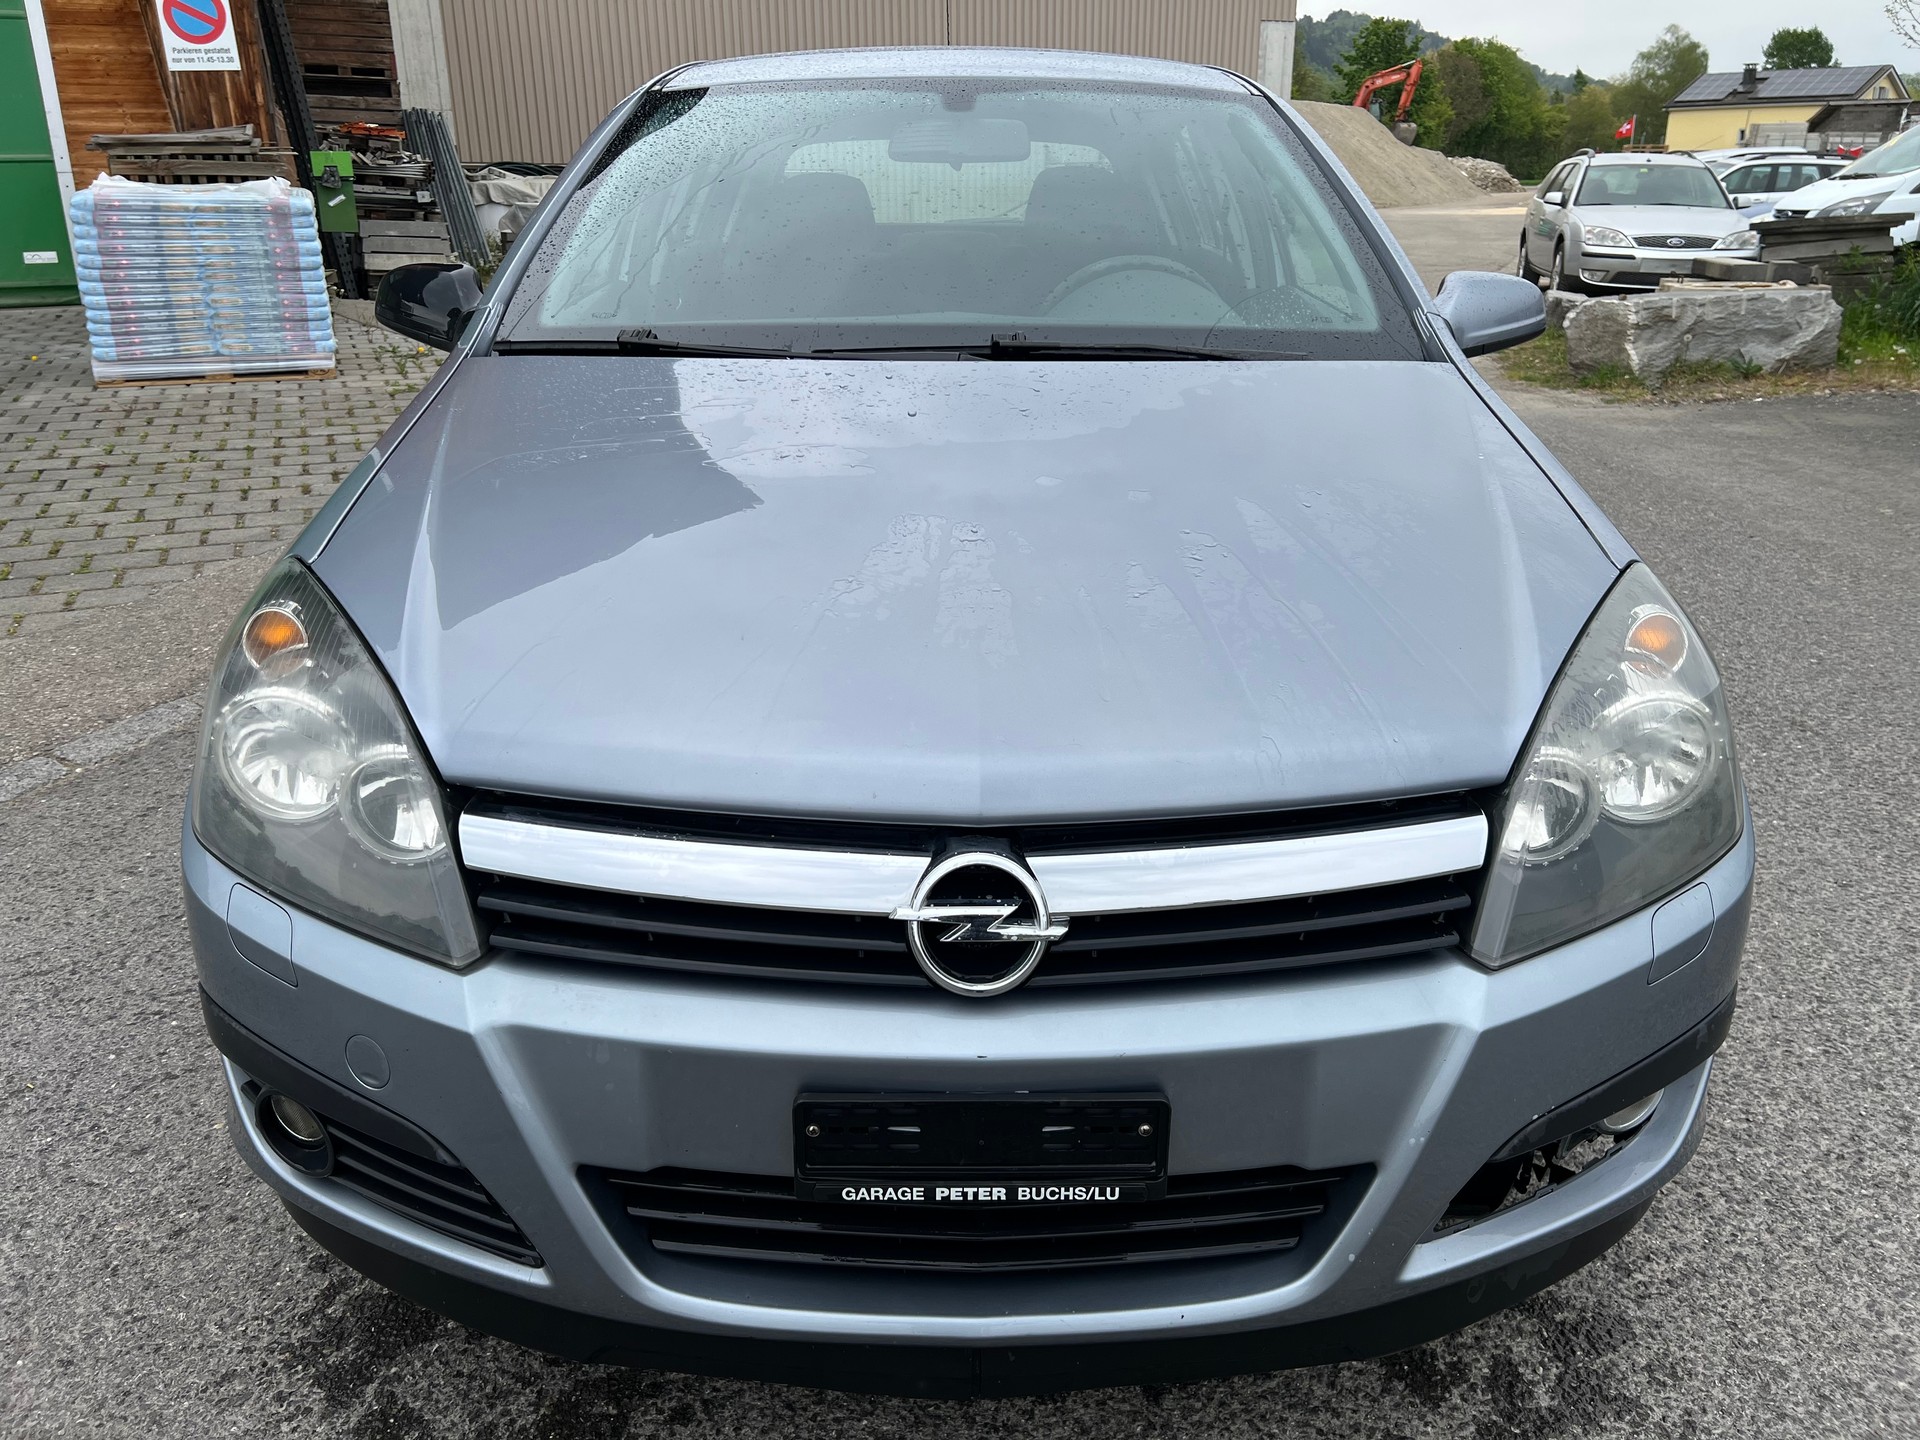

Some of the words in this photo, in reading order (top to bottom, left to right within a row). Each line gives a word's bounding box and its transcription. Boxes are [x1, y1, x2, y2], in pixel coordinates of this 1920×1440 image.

[203, 47, 231, 55] gestattet
[841, 1187, 925, 1201] GARAGE
[935, 1187, 1007, 1201] PETER
[1017, 1186, 1120, 1201] BUCHS/LU
